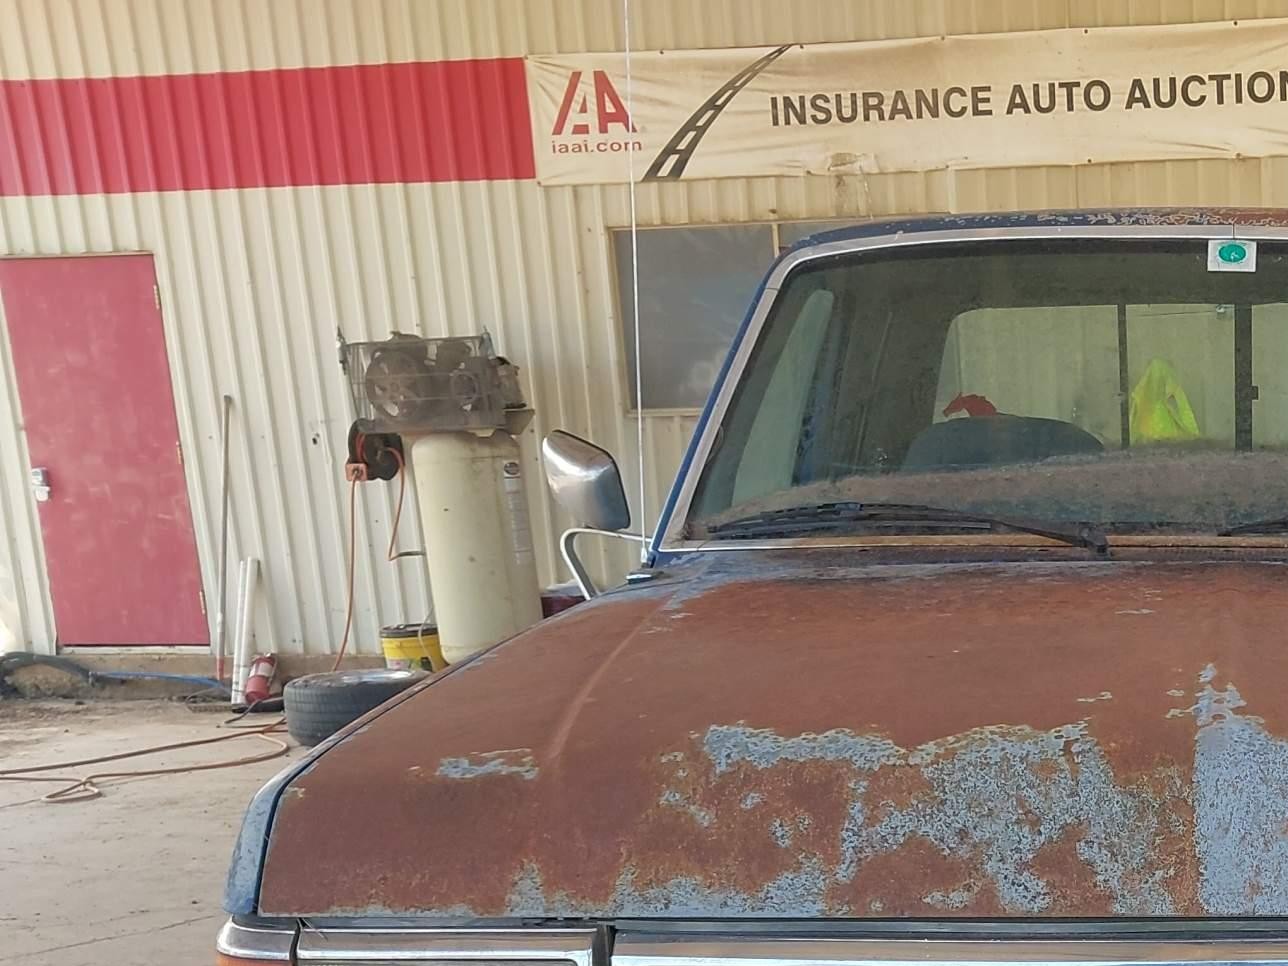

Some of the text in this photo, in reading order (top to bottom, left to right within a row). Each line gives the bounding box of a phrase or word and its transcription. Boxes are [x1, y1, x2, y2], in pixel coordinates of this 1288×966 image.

[770, 85, 993, 127] INSURANCE
[1005, 79, 1112, 116] AUTO
[551, 139, 642, 154] iaai.com
